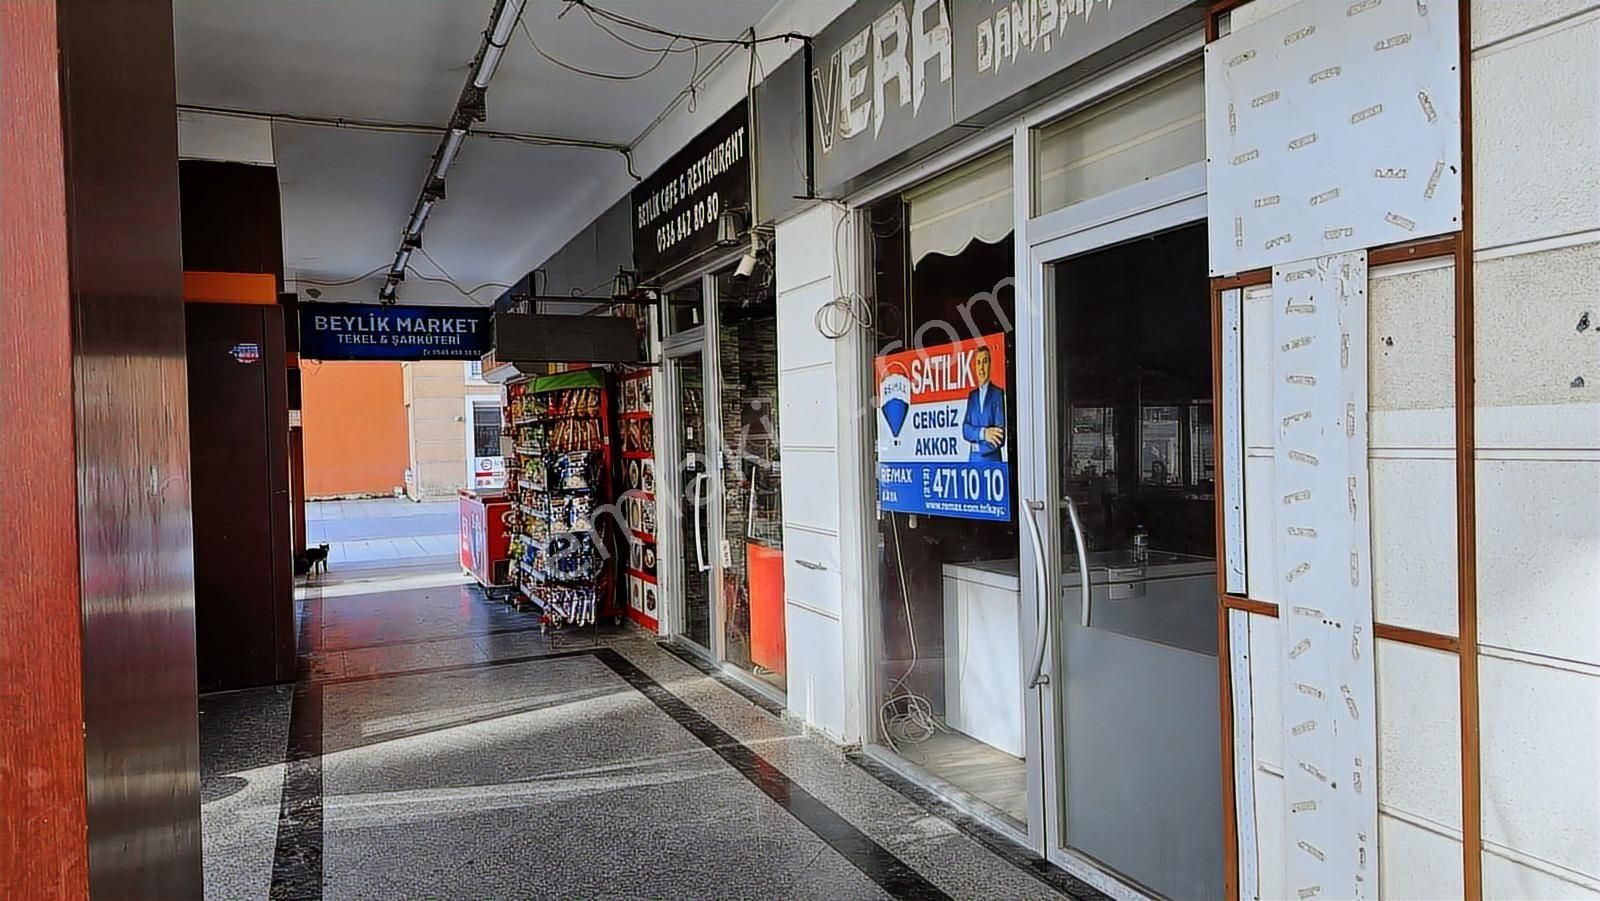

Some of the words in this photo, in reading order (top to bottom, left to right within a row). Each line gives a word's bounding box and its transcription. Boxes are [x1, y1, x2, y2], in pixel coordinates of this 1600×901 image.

[812, 0, 951, 154] VERA
[638, 191, 660, 228] BEYLİK
[660, 178, 679, 213] CAFE
[687, 126, 744, 195] RESTAURANT
[656, 220, 675, 253] 0536
[693, 201, 705, 231] 80
[706, 191, 719, 223] 80
[314, 313, 390, 332] BEYLİK
[396, 317, 479, 333] MARKET
[337, 334, 377, 344] TEKEL
[380, 335, 388, 344] &
[391, 333, 460, 346] ŞARKÜTERİ
[911, 349, 975, 395] SATILIK
[912, 405, 959, 429] CENGİZ
[915, 437, 958, 456] AKKOR
[880, 467, 913, 483] RE/MAX
[933, 468, 958, 499] 471
[961, 468, 980, 500] 10
[984, 468, 1004, 502] 10
